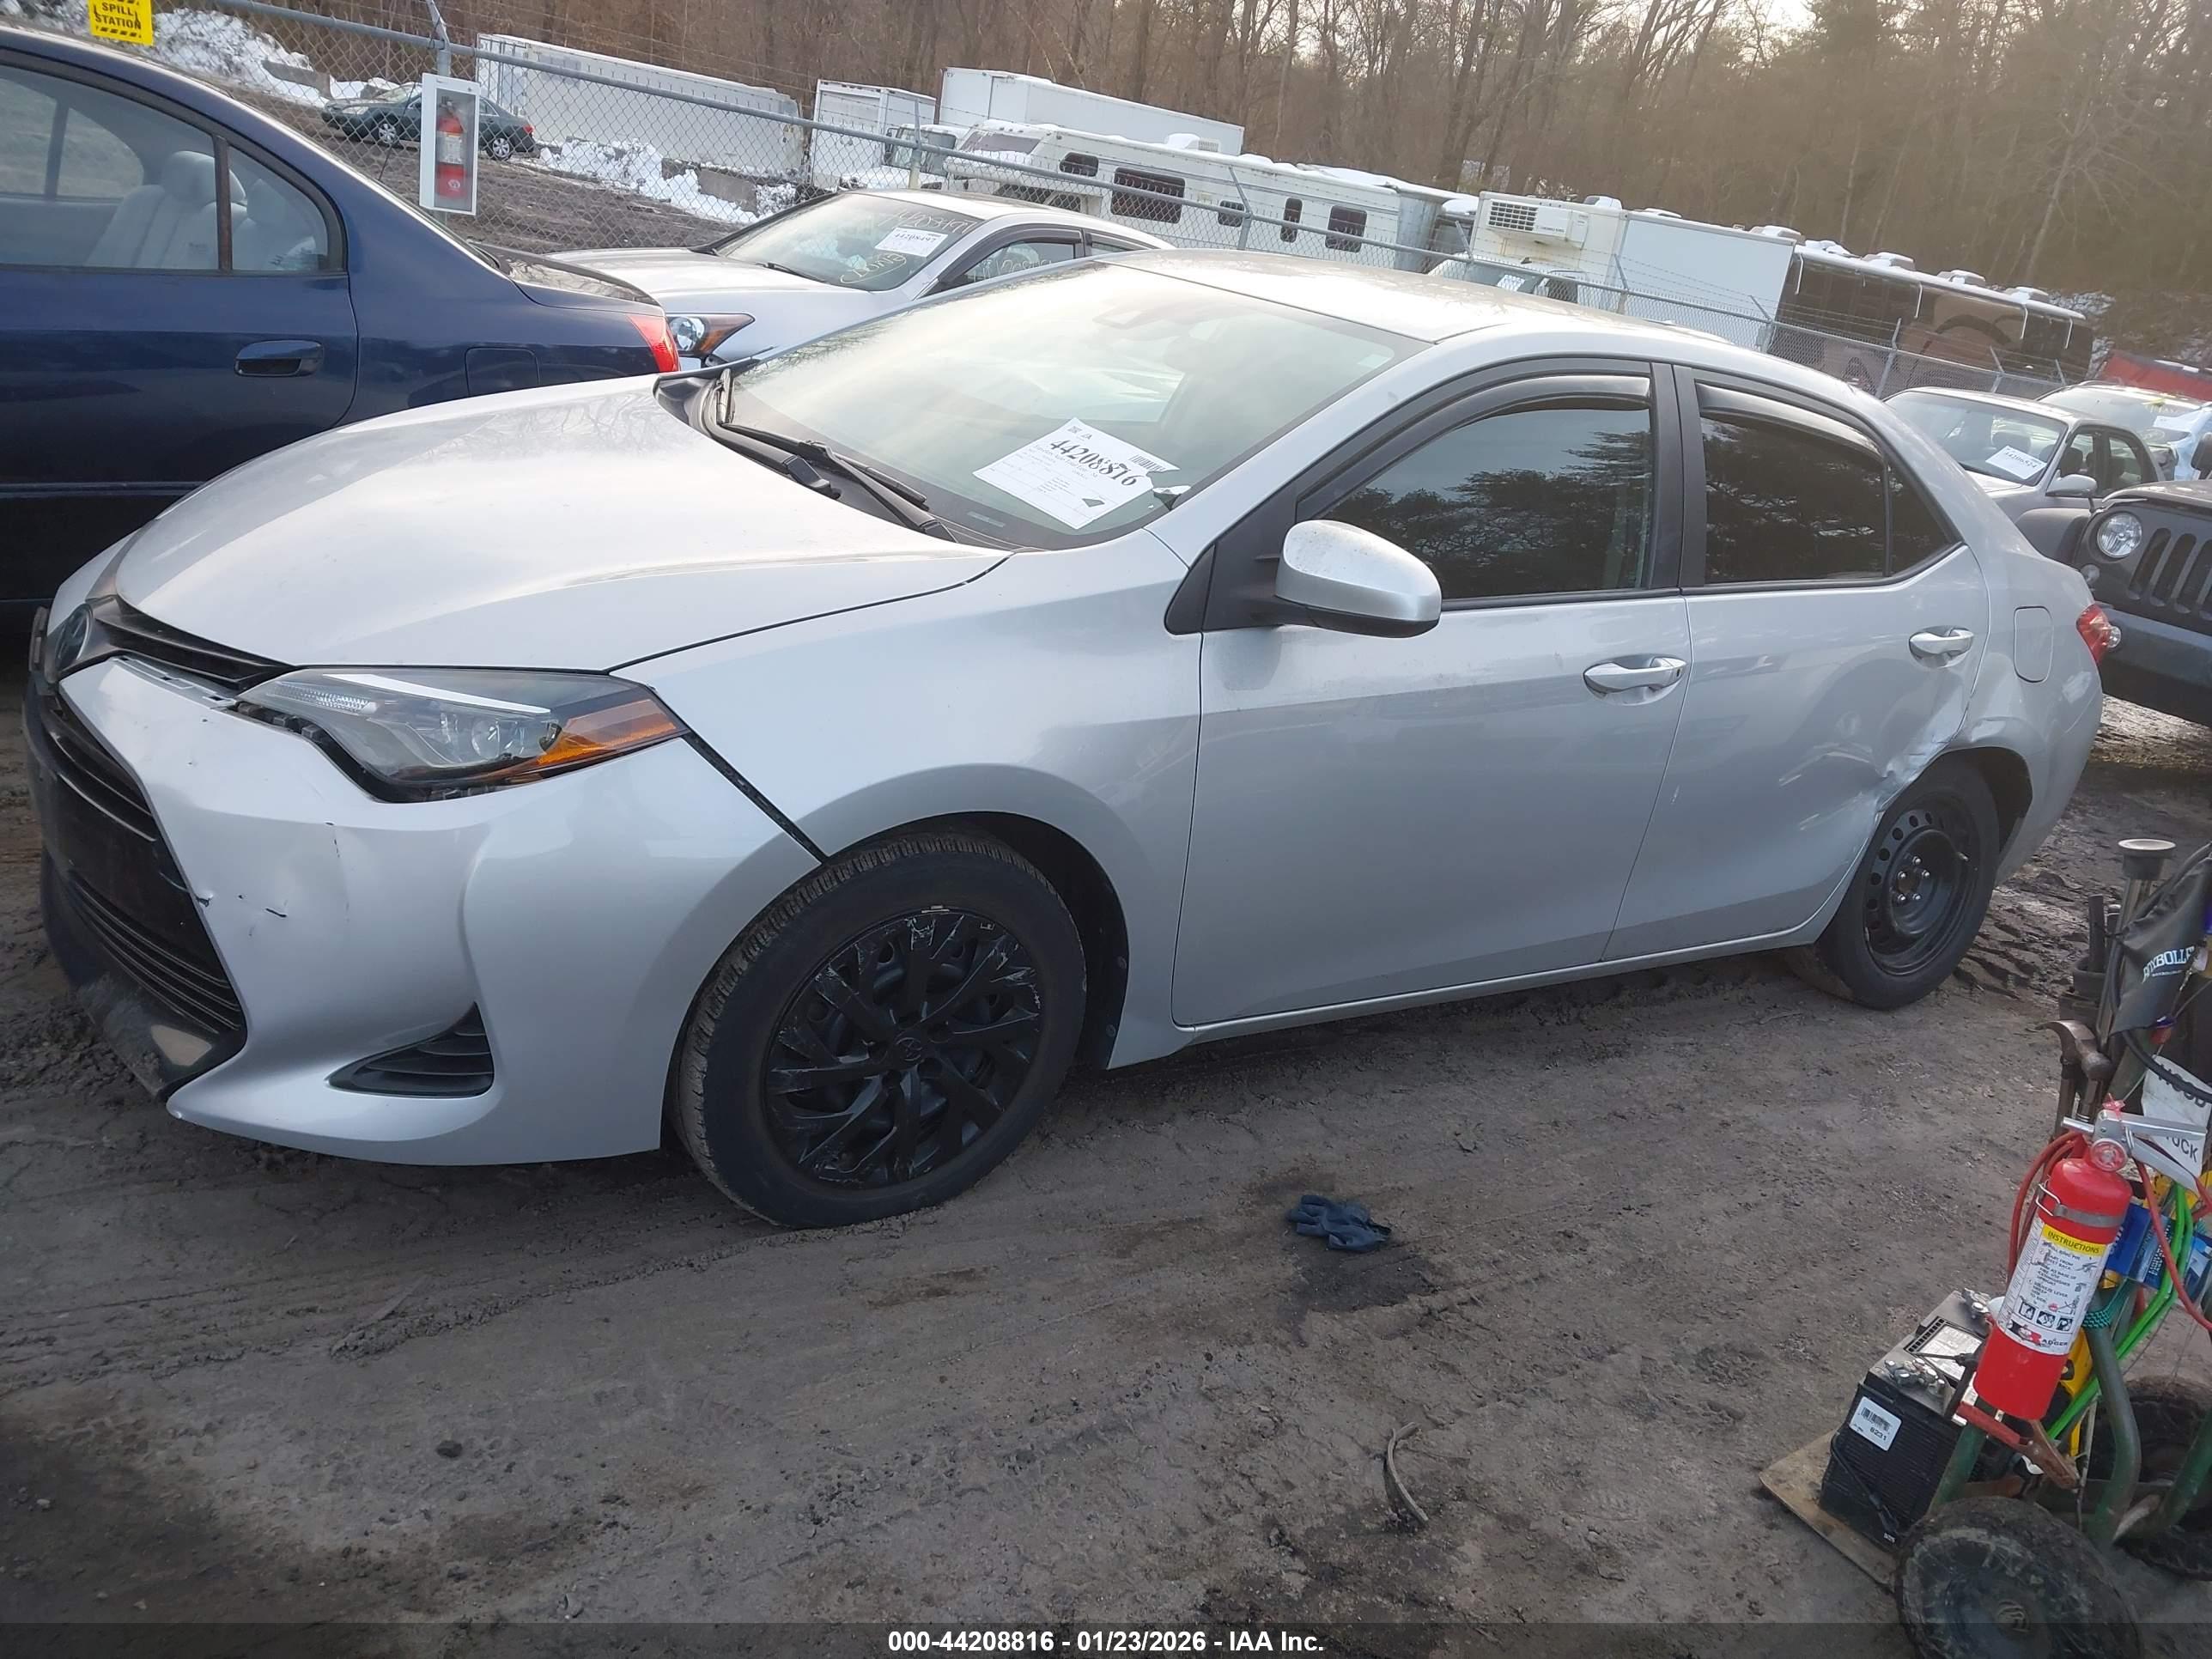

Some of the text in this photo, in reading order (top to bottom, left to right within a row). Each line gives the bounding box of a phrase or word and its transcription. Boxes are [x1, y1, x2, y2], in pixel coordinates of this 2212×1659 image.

[102, 3, 134, 16] SPILL
[94, 13, 142, 29] STATION
[1049, 439, 1139, 486] 44208816
[2048, 1231, 2100, 1254] INSTRUCTIONS
